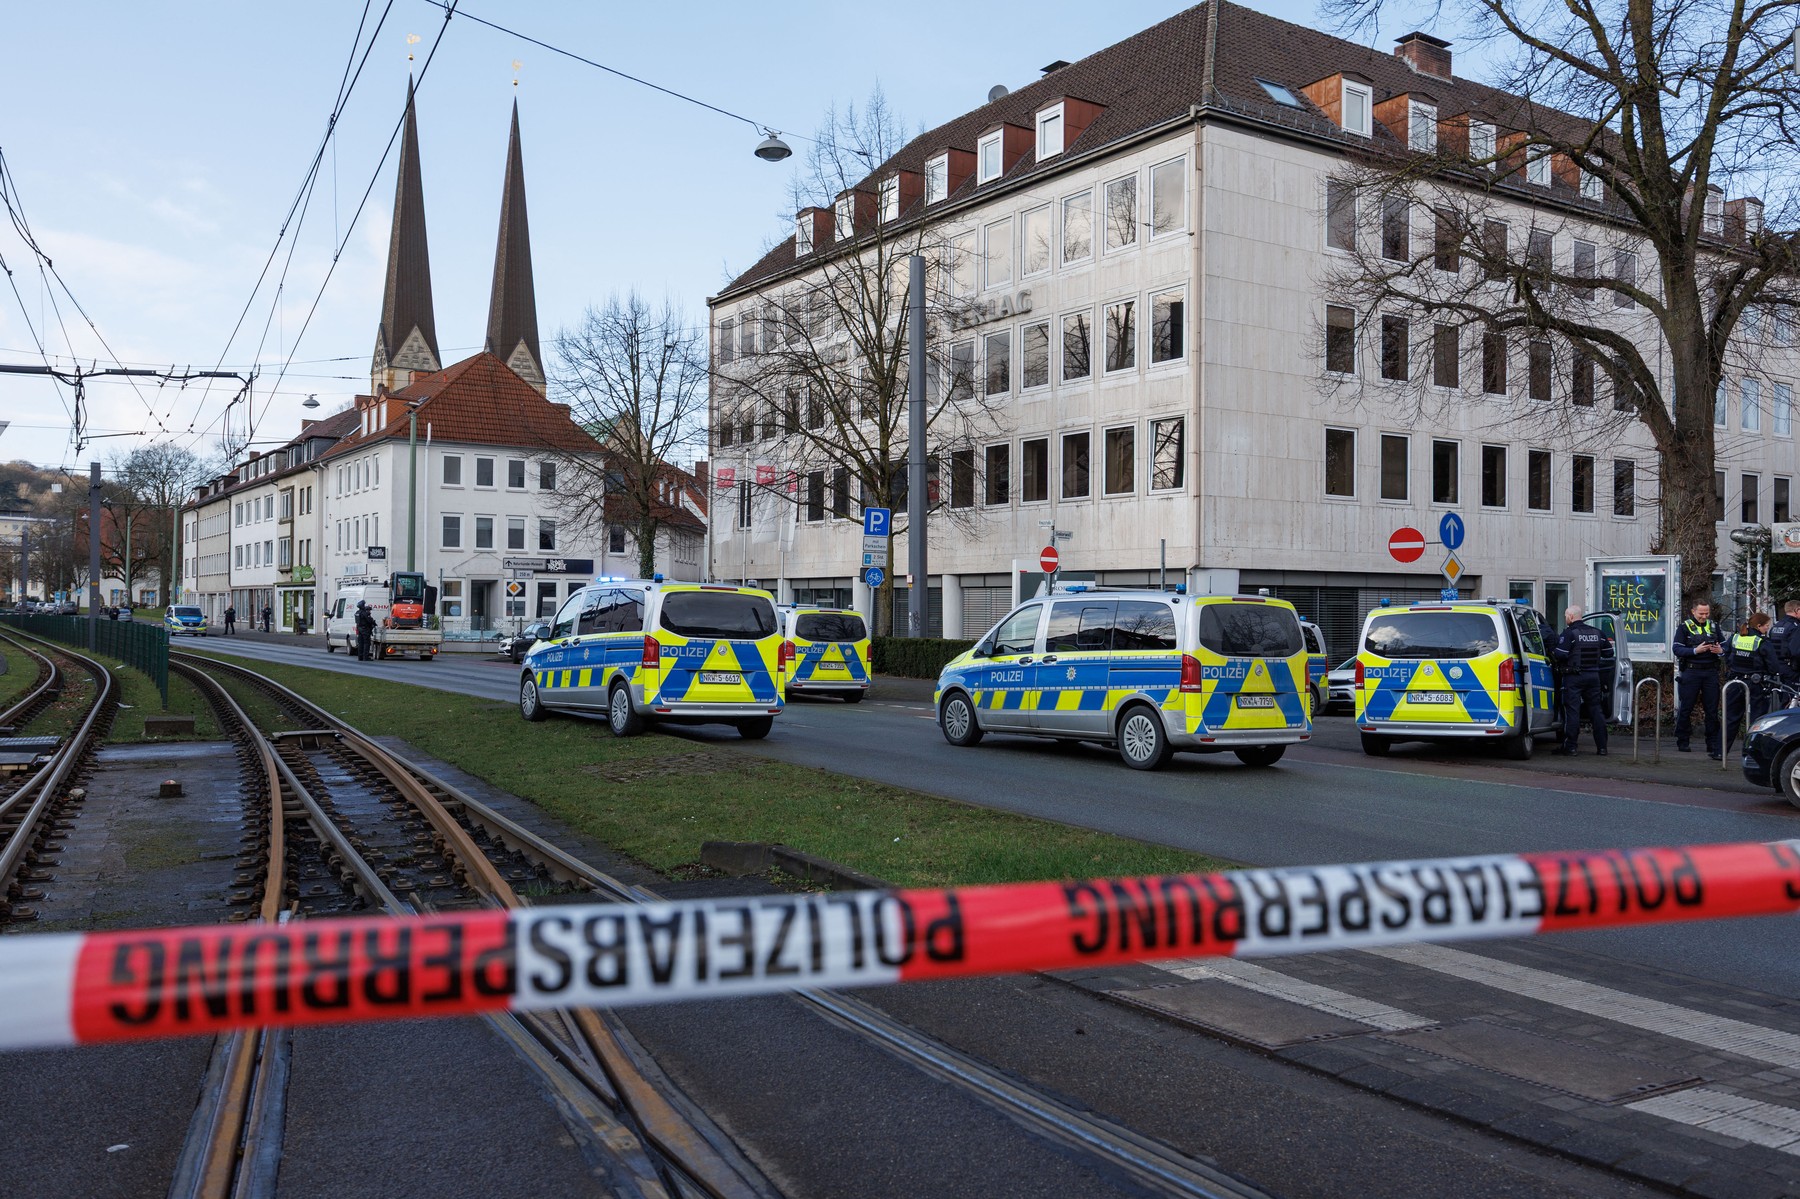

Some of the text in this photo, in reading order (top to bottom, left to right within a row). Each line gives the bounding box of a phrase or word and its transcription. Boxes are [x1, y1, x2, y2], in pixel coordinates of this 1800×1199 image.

[870, 511, 884, 532] P
[1609, 584, 1645, 596] ELEC
[1609, 597, 1642, 609] TRIC
[1622, 609, 1659, 622] MEN
[1578, 634, 1599, 642] POLIZEI
[661, 646, 707, 658] POLIZEI
[796, 646, 824, 654] POLIZEI
[546, 651, 564, 663] POLIZEI
[990, 670, 1024, 683] POLIZEI
[1203, 667, 1245, 679] POLIZEI
[1365, 668, 1411, 678] POLIZEI
[1068, 848, 1703, 953] POLIZEIABSPERRUNG
[108, 891, 965, 1026] POLIZEIABSPERRUNG
